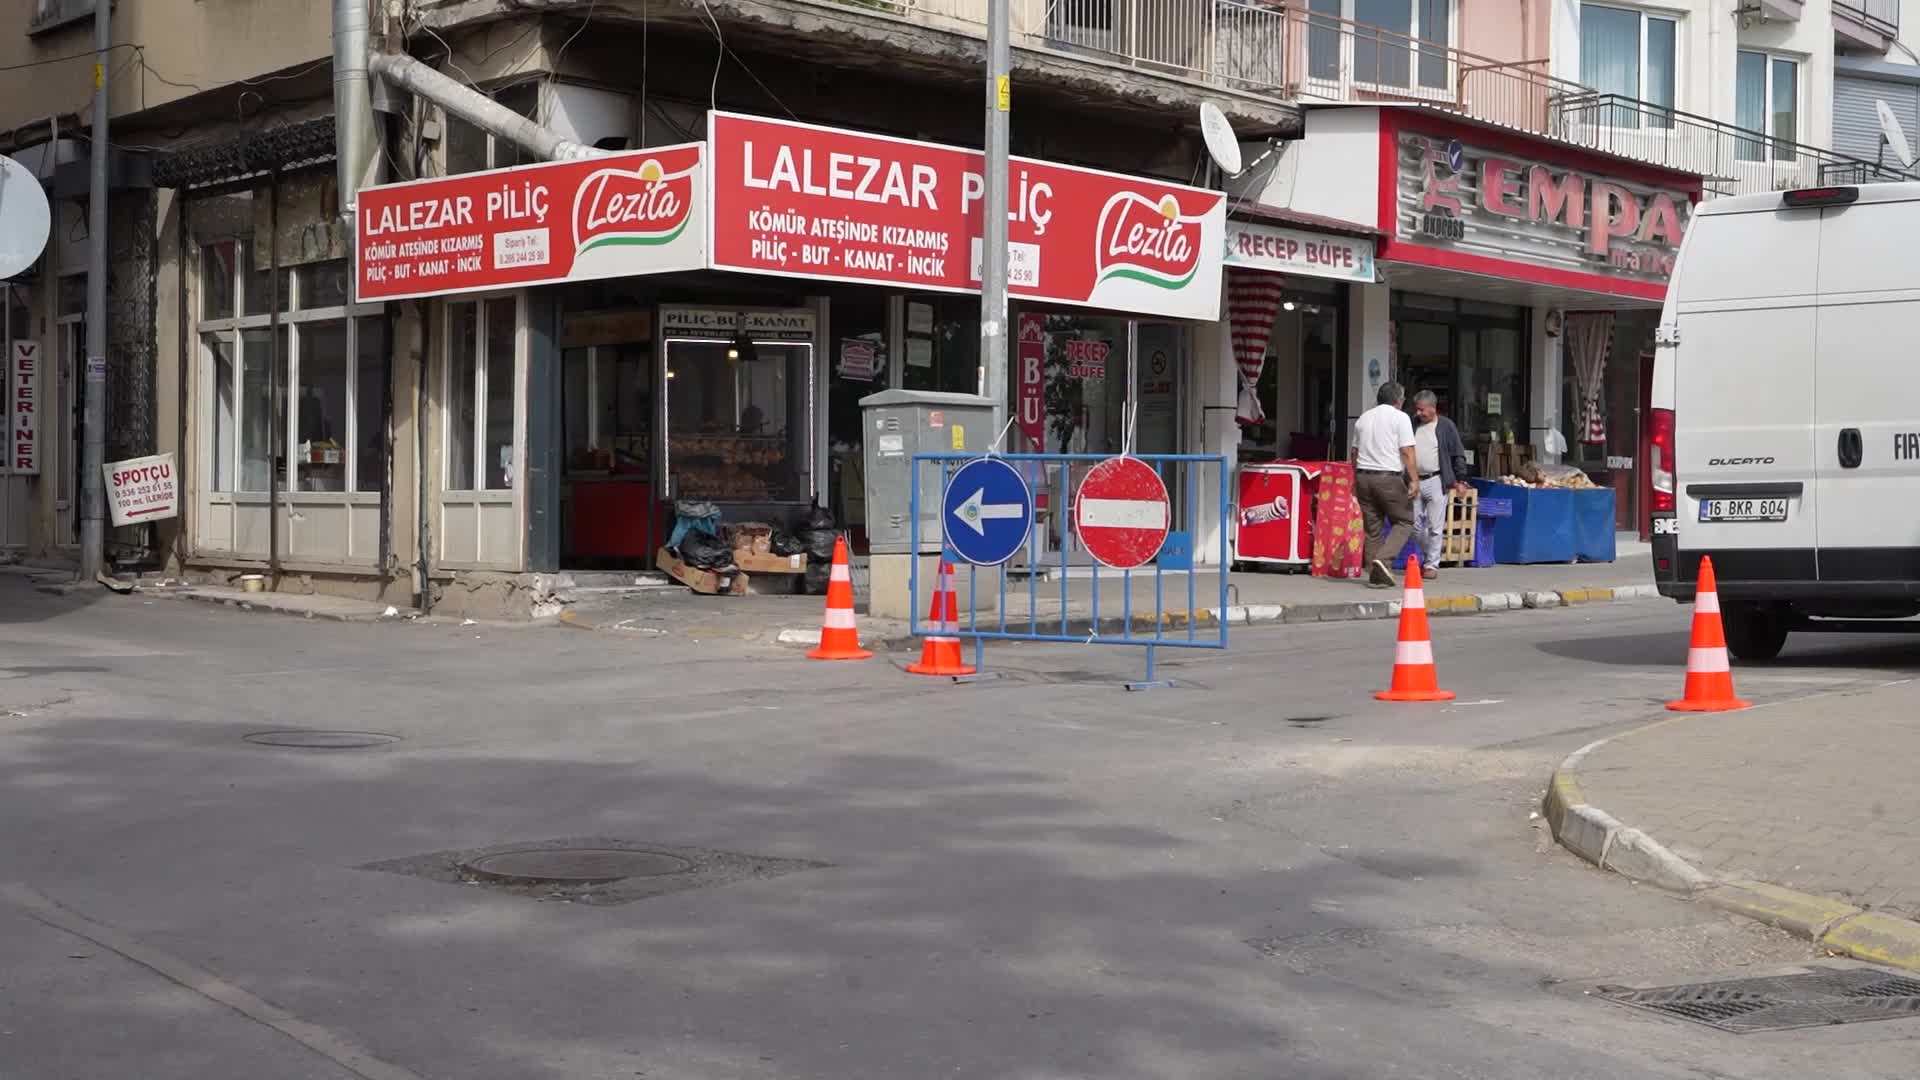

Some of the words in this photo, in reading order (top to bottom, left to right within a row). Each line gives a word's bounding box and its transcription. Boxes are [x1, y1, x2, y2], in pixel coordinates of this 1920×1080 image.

[587, 174, 681, 230] Lezita
[744, 141, 938, 210] LALEZAR
[961, 170, 1053, 235] PİÇ
[365, 196, 473, 236] LALEZAR
[487, 181, 549, 223] PİLİÇ
[1480, 158, 1685, 256] EMPA
[749, 205, 806, 235] KÖMÜR
[810, 215, 878, 244] ATEŞİNDE
[883, 225, 949, 255] KIZARMIŞ
[1109, 198, 1192, 262] Lezita
[1423, 215, 1465, 239] express
[365, 240, 396, 261] KÖMÜR
[399, 236, 439, 260] ATEŞİNDE
[441, 234, 484, 253] KIZARMIŞ
[752, 234, 787, 266] PİLİÇ
[802, 244, 830, 265] BUT
[844, 249, 894, 272] KANAT
[907, 250, 945, 277] İNCİK
[1238, 232, 1298, 261] RECEP
[1305, 239, 1353, 268] BÜFE
[1611, 249, 1676, 275] marke
[367, 262, 387, 284] PİLİÇ
[394, 263, 411, 279] BUT
[419, 259, 449, 277] KANAT
[457, 252, 482, 273] İNCİK
[1065, 341, 1109, 362] RECEP
[1023, 357, 1041, 444] BÜ
[1708, 457, 1775, 466] DUCATO
[1894, 432, 1920, 460] FIA
[112, 463, 170, 487] SPOTÇU
[118, 499, 131, 508] 100
[1709, 501, 1721, 515] 16
[1728, 501, 1753, 515] BKR
[1760, 500, 1784, 515] 604
